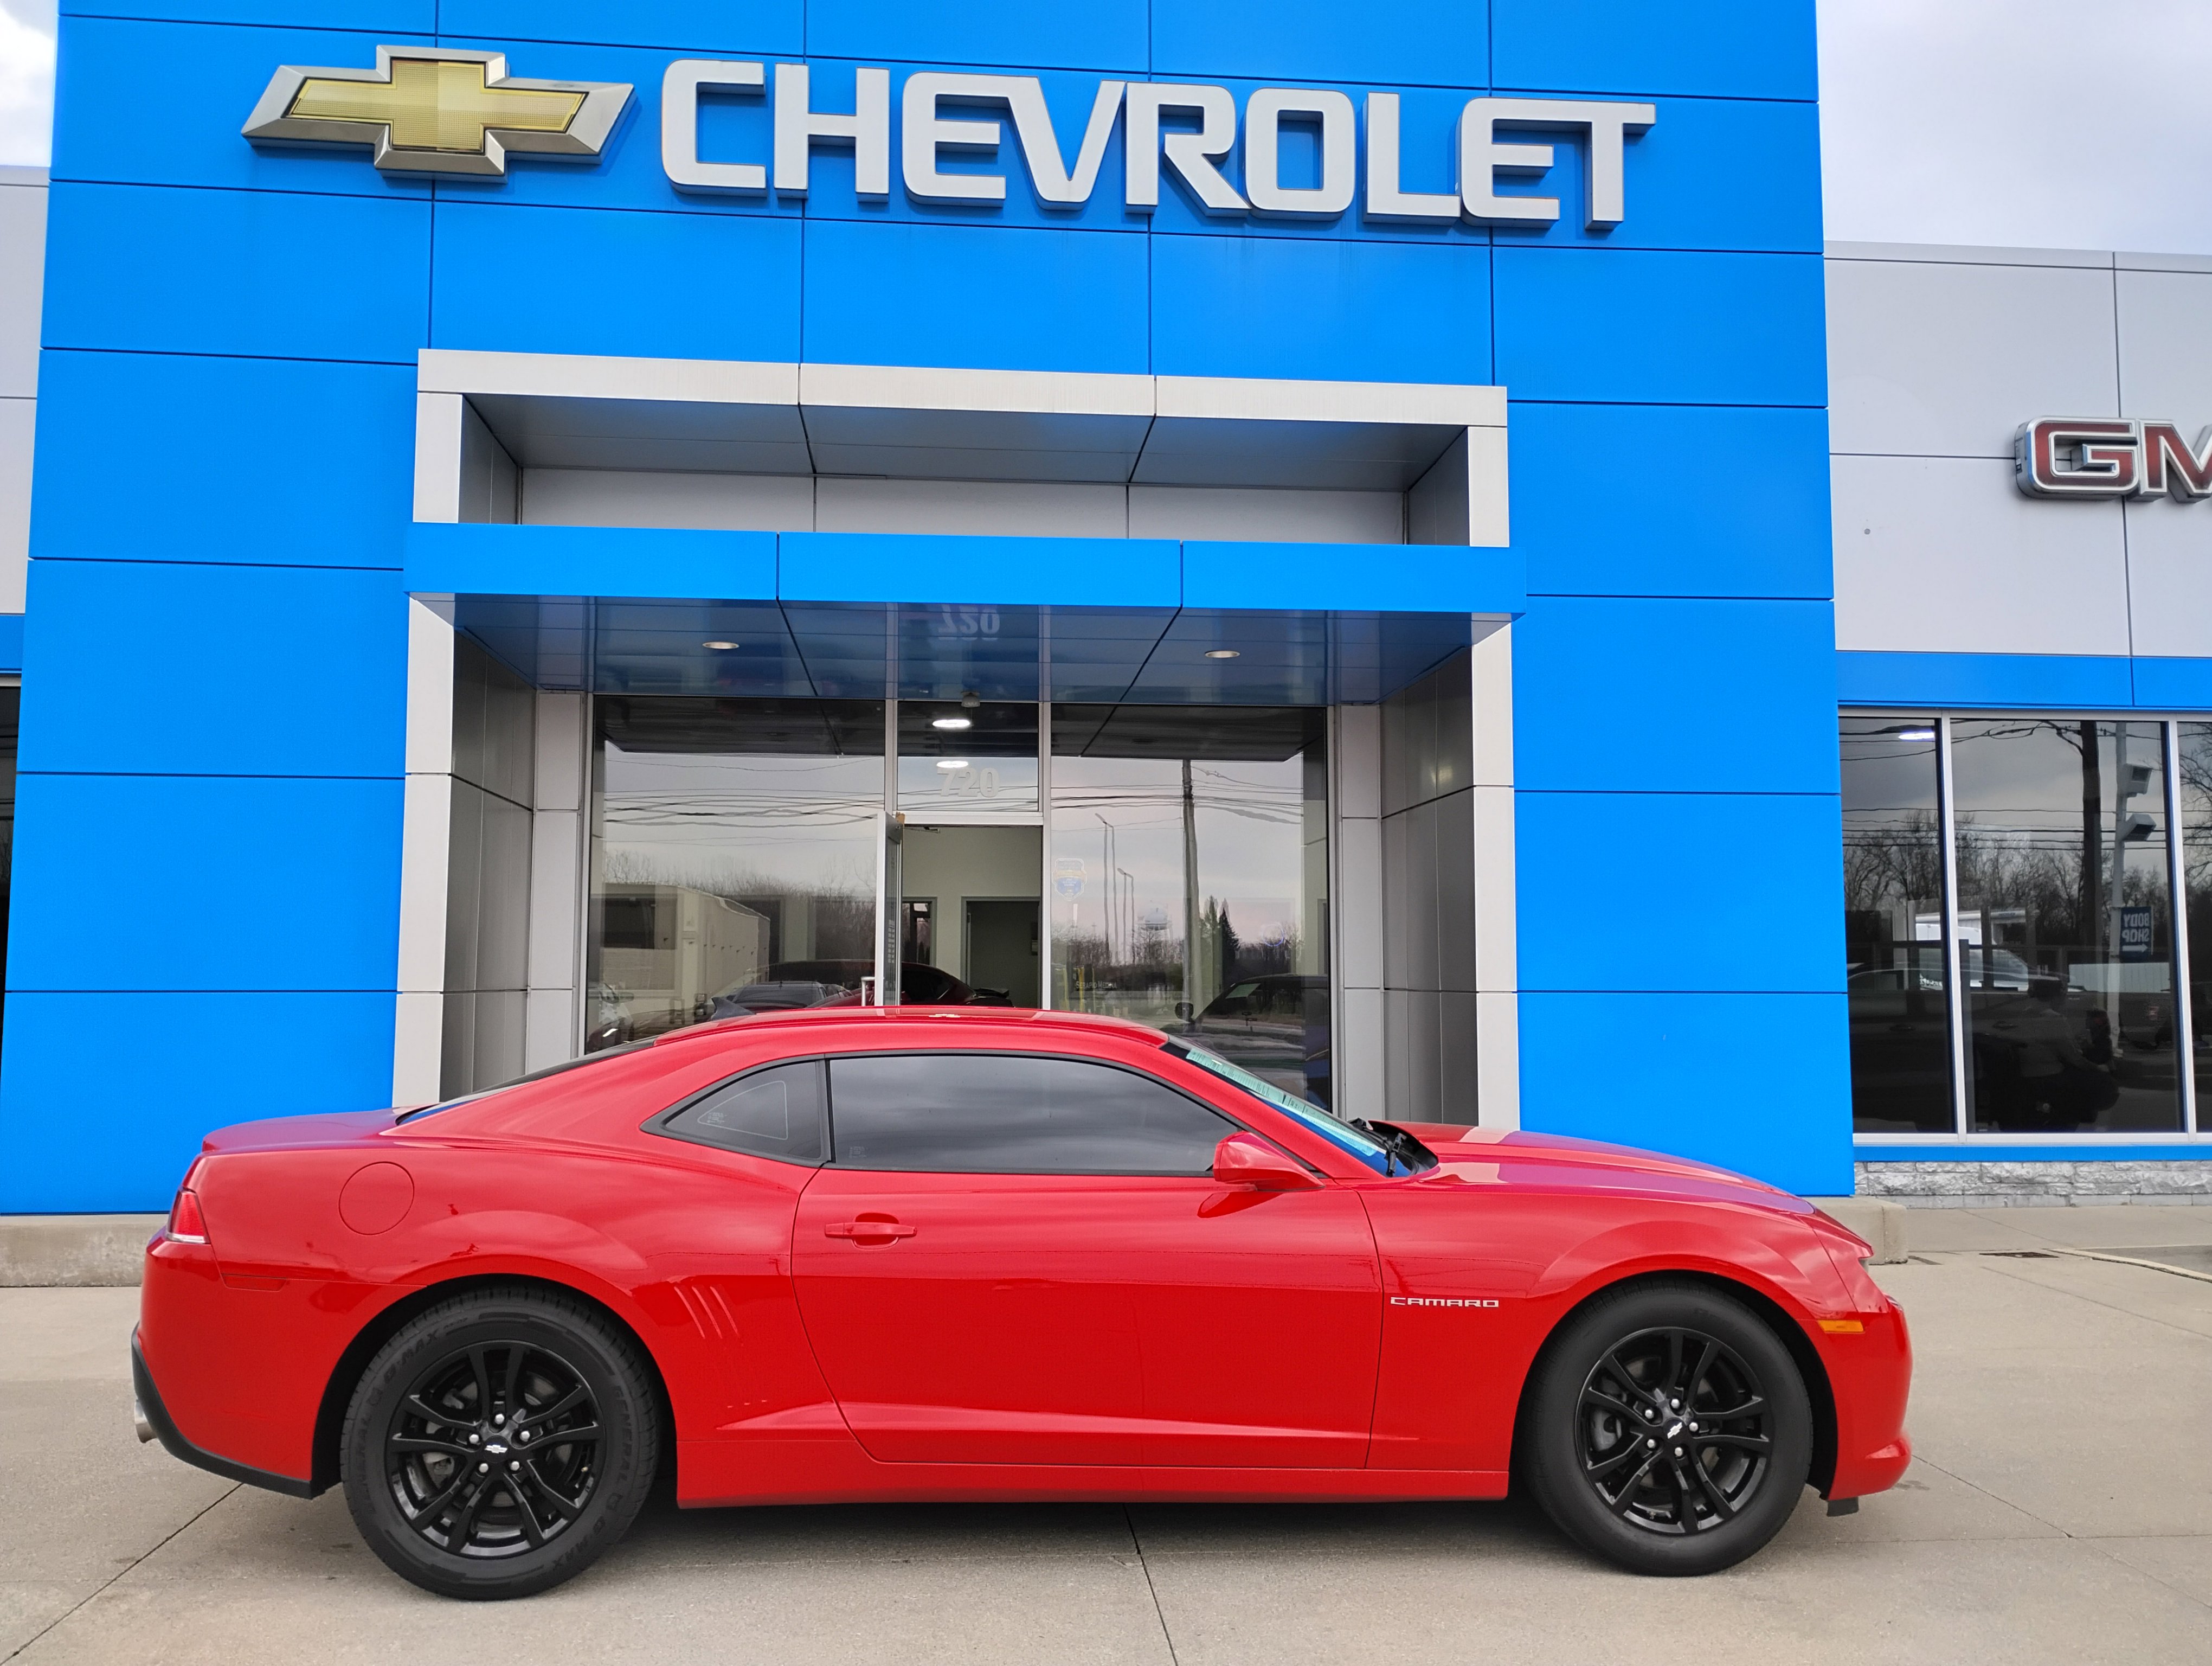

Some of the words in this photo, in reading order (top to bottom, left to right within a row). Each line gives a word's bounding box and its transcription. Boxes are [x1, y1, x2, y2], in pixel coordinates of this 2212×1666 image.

[661, 57, 1657, 229] CHEVROLET
[937, 767, 999, 798] 720
[1390, 1296, 1499, 1308] CAMARO
